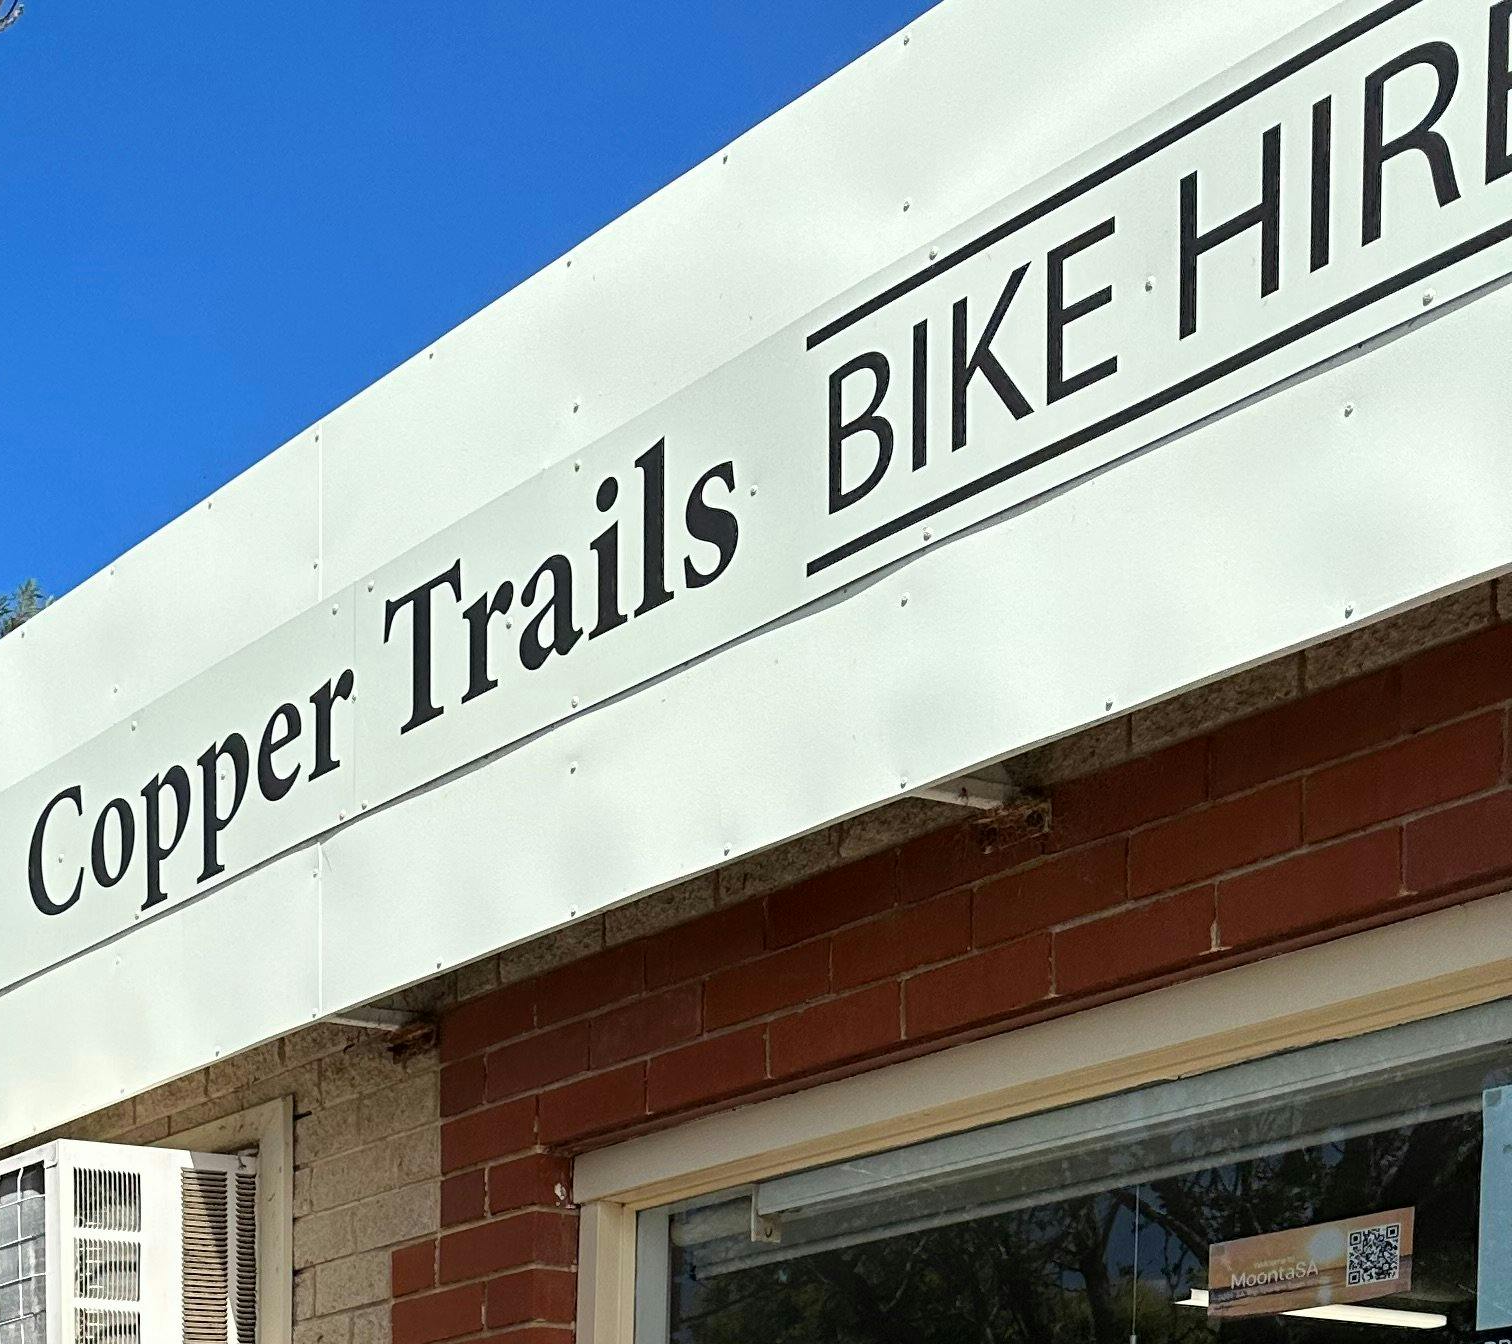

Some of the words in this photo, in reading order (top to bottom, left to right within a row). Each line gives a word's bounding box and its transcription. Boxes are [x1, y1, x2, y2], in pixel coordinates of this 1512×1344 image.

[828, 215, 1118, 515] BIKE
[1179, 5, 1512, 341] HIR
[28, 667, 355, 916] Copper
[384, 435, 739, 735] Trails
